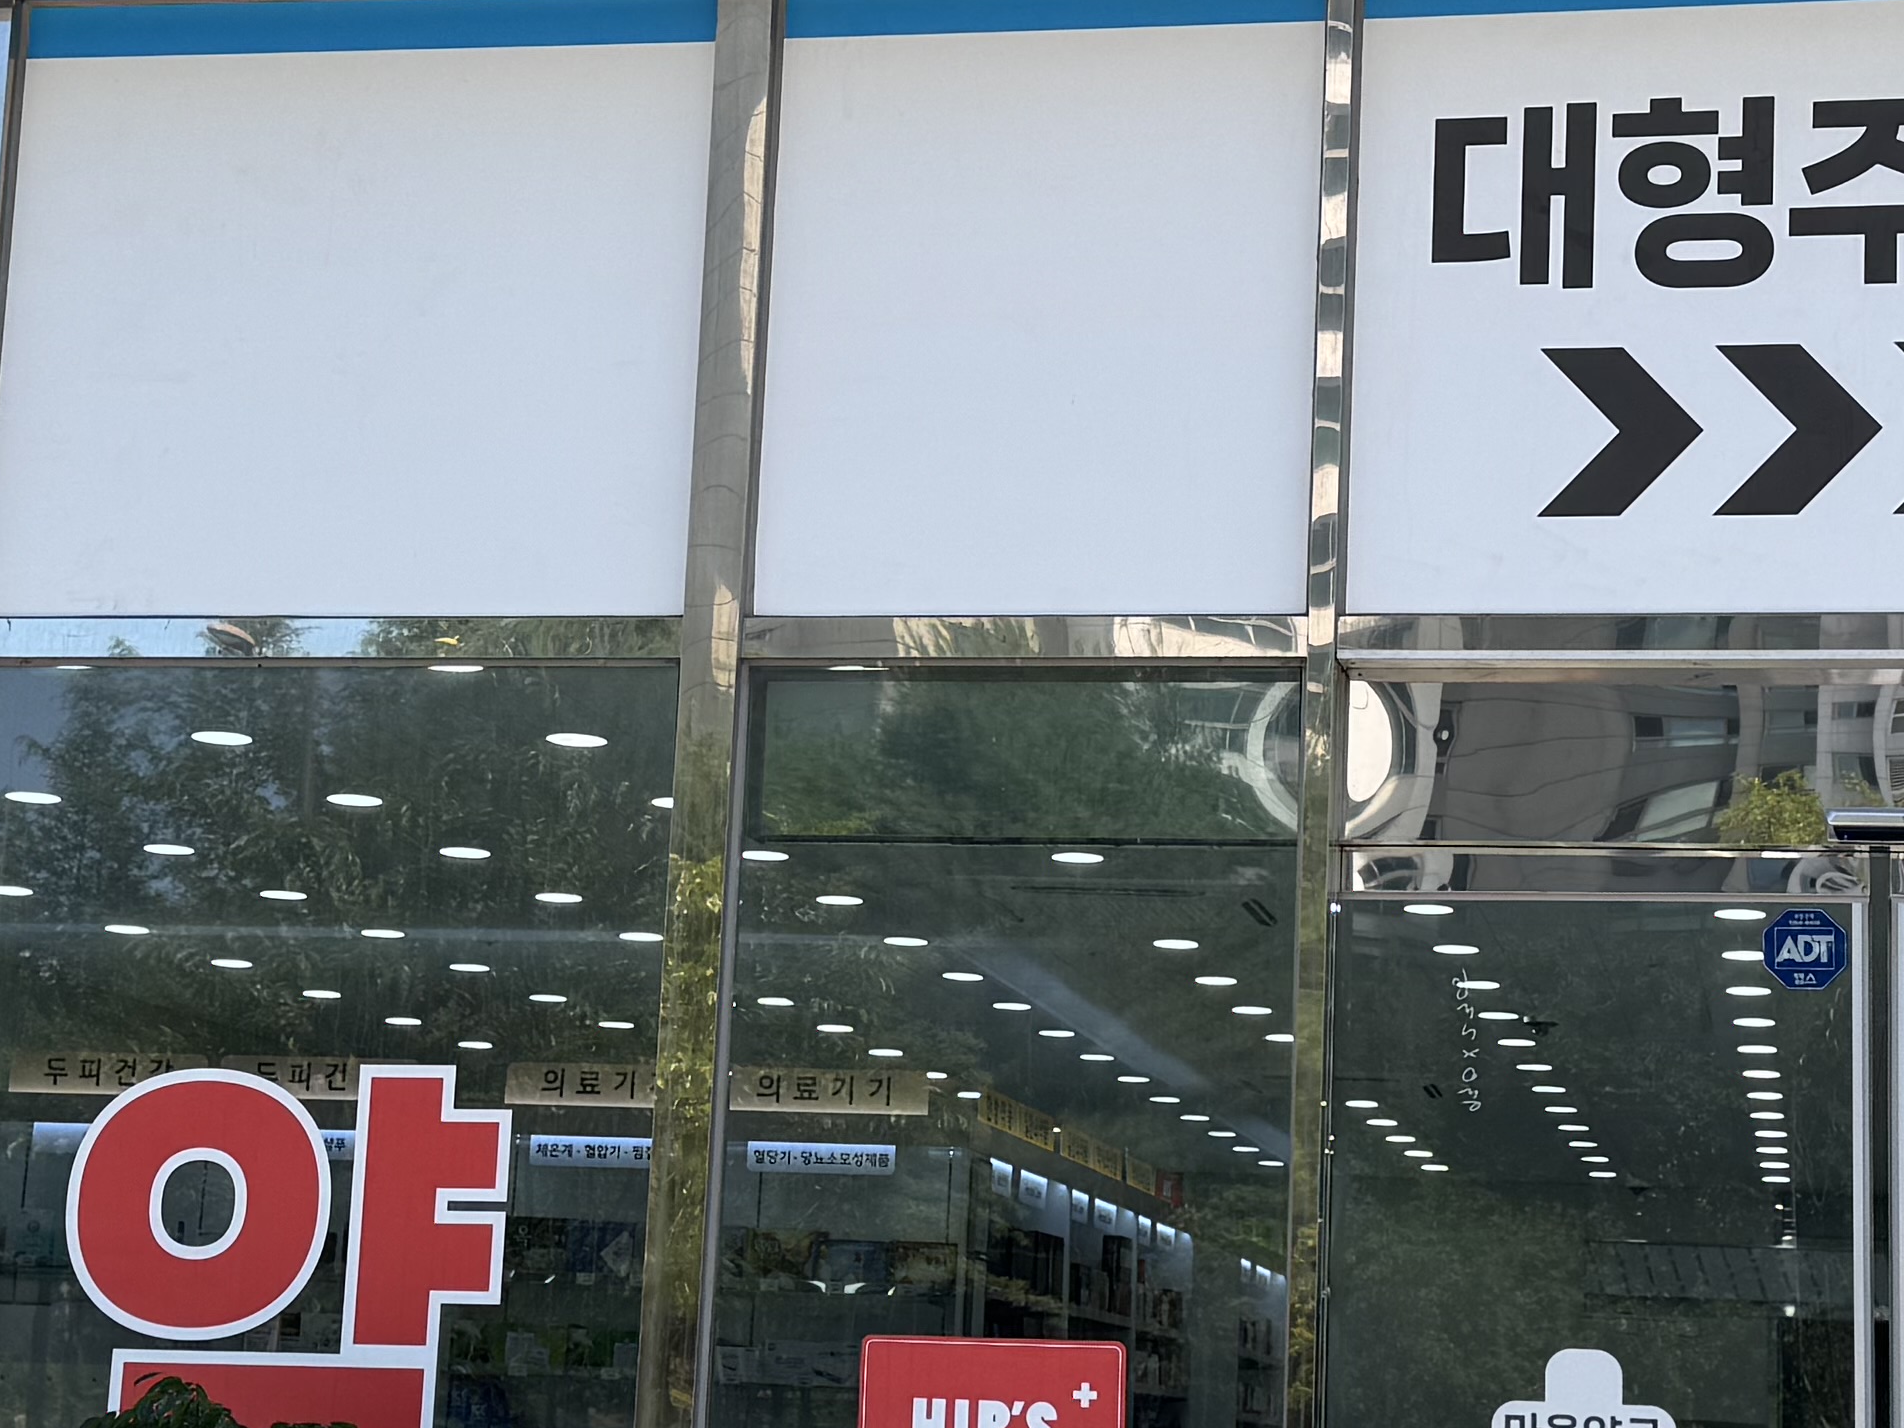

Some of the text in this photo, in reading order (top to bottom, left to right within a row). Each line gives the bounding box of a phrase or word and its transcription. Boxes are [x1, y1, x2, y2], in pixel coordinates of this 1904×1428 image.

[1776, 934, 1835, 963] ADT
[257, 1062, 347, 1092] 두피건
[540, 1068, 892, 1105] 의료기 의료기기
